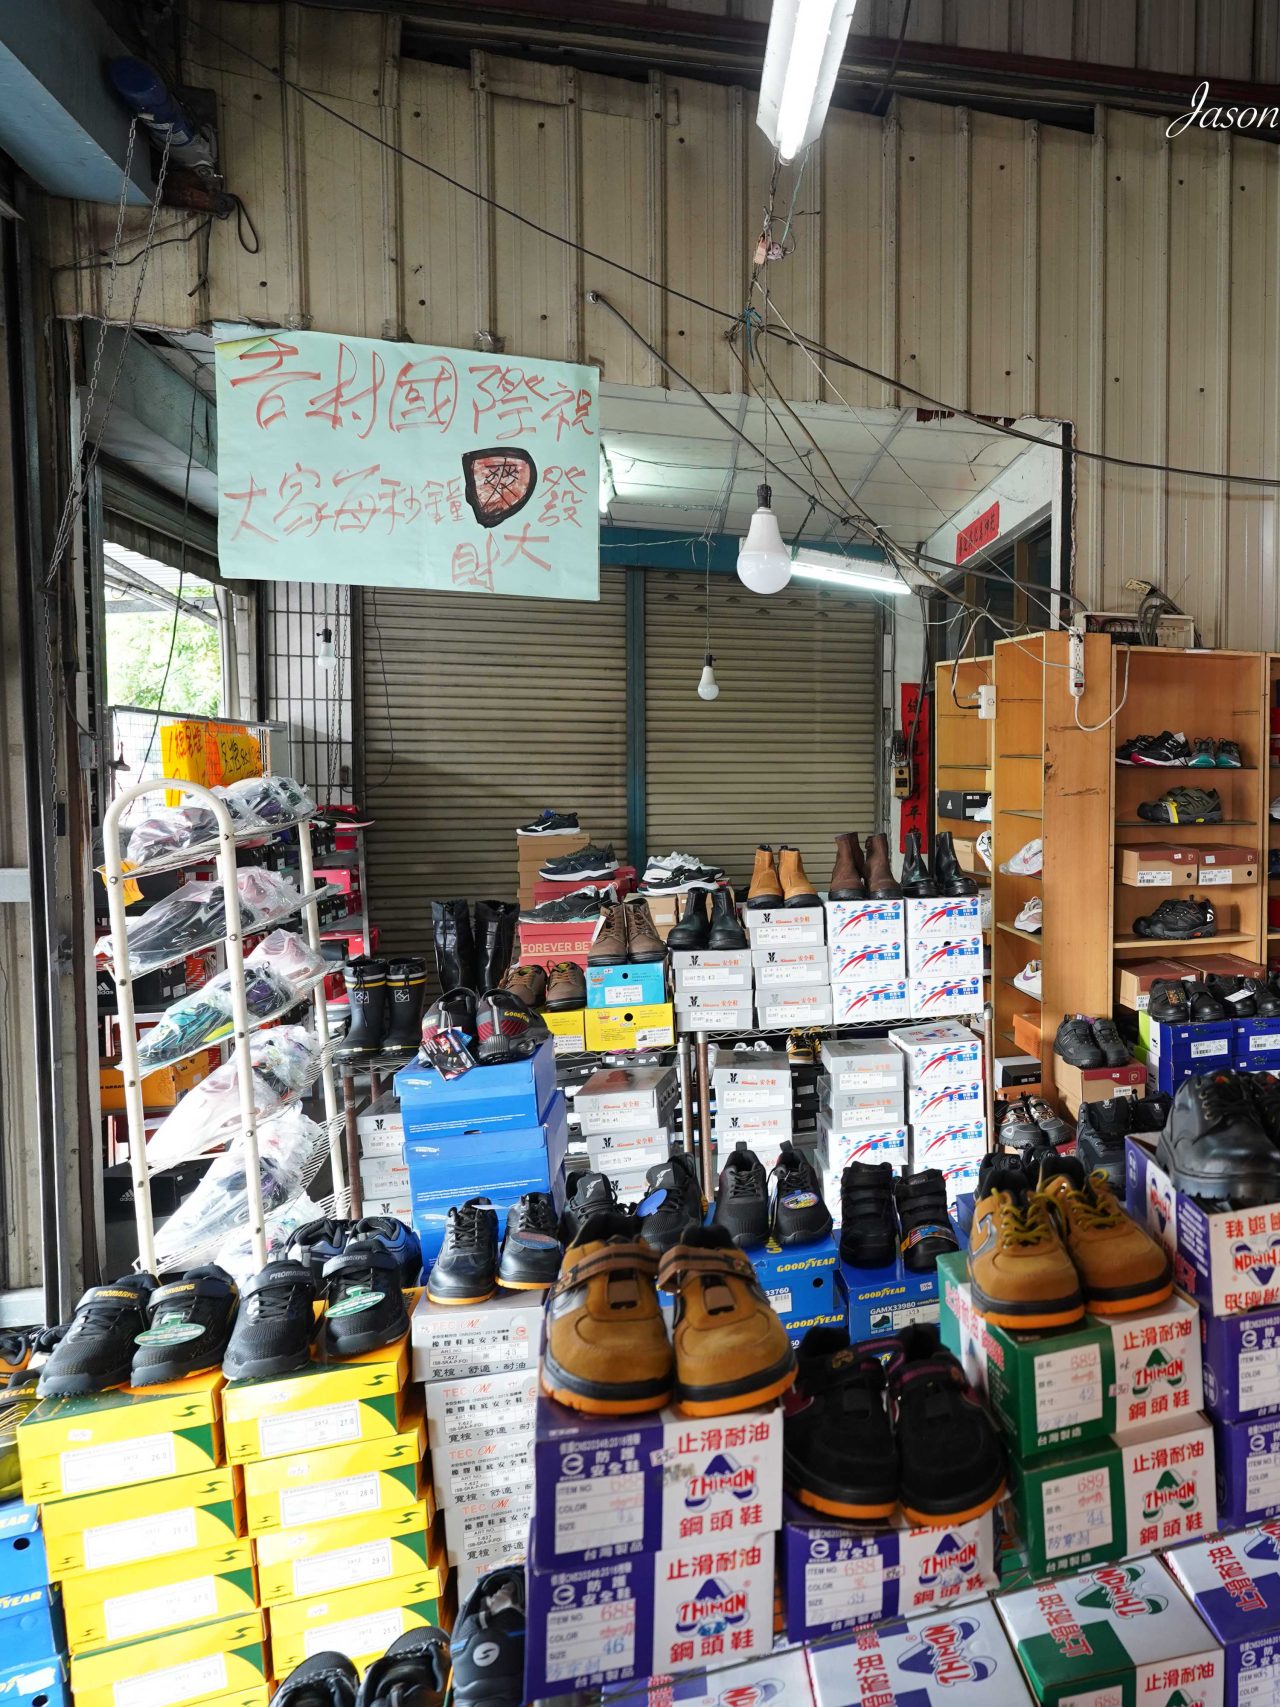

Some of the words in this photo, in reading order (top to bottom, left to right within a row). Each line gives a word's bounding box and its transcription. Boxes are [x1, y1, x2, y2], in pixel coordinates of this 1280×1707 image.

[522, 941, 571, 953] FOREVER
[777, 1257, 836, 1273] GOODYEAR
[858, 1287, 906, 1300] GOODYEAR
[786, 1314, 844, 1330] GOODYEAR
[1122, 1318, 1192, 1352] 止滑耐油
[1135, 1359, 1184, 1386] THIMON
[1128, 1389, 1190, 1422] 鋼頭鞋
[677, 1422, 770, 1455] 止滑耐油
[1132, 1440, 1204, 1475] 止滑耐油
[689, 1468, 755, 1498] THIMON
[1145, 1480, 1195, 1509] THIMON
[679, 1504, 762, 1539] 鋼頭鞋
[1139, 1512, 1202, 1546] 鋼頭鞋
[666, 1546, 761, 1581] 止滑耐油
[922, 1543, 977, 1575] THIMON
[913, 1574, 985, 1606] 鋼頭鞋
[681, 1591, 747, 1623] THIMON
[670, 1628, 754, 1664] 鋼頭鞋
